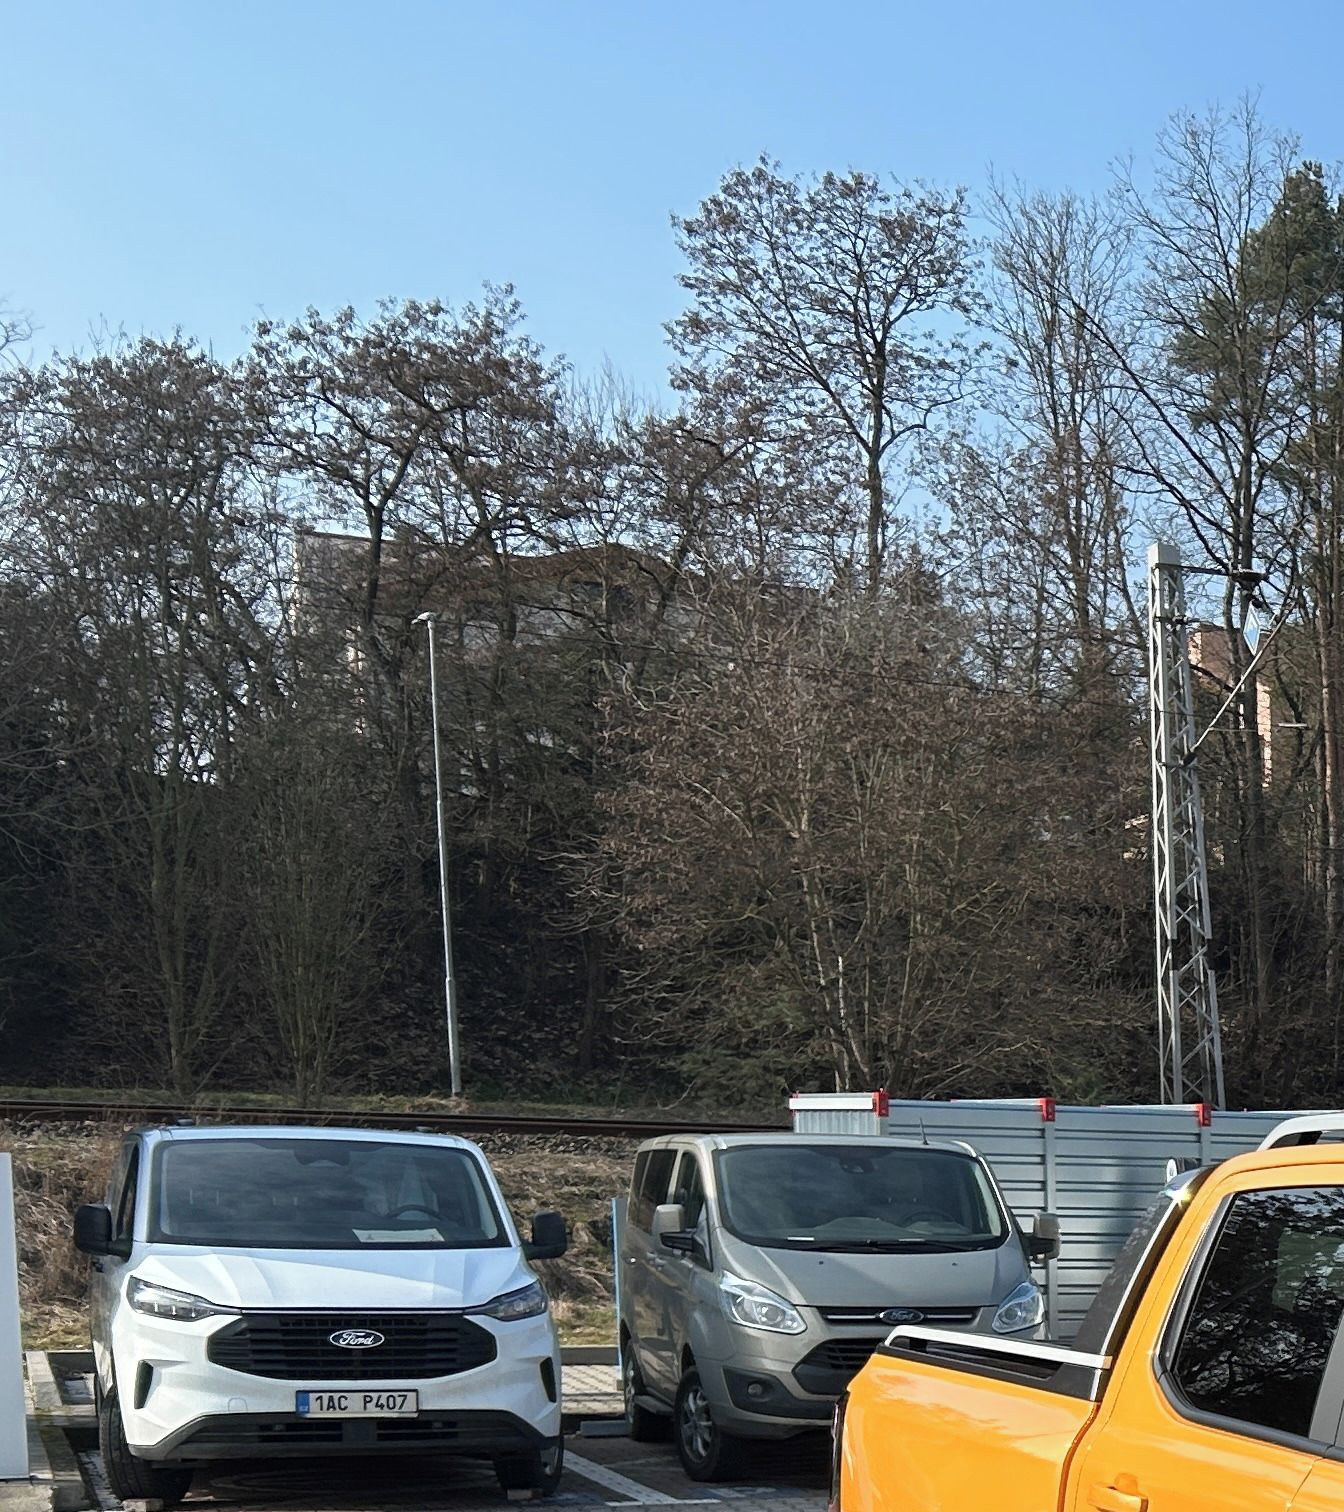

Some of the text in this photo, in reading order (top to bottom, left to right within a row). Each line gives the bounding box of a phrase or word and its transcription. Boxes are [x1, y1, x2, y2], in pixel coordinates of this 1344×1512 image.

[339, 1332, 375, 1345] Ford
[315, 1394, 408, 1412] 1AC P407
